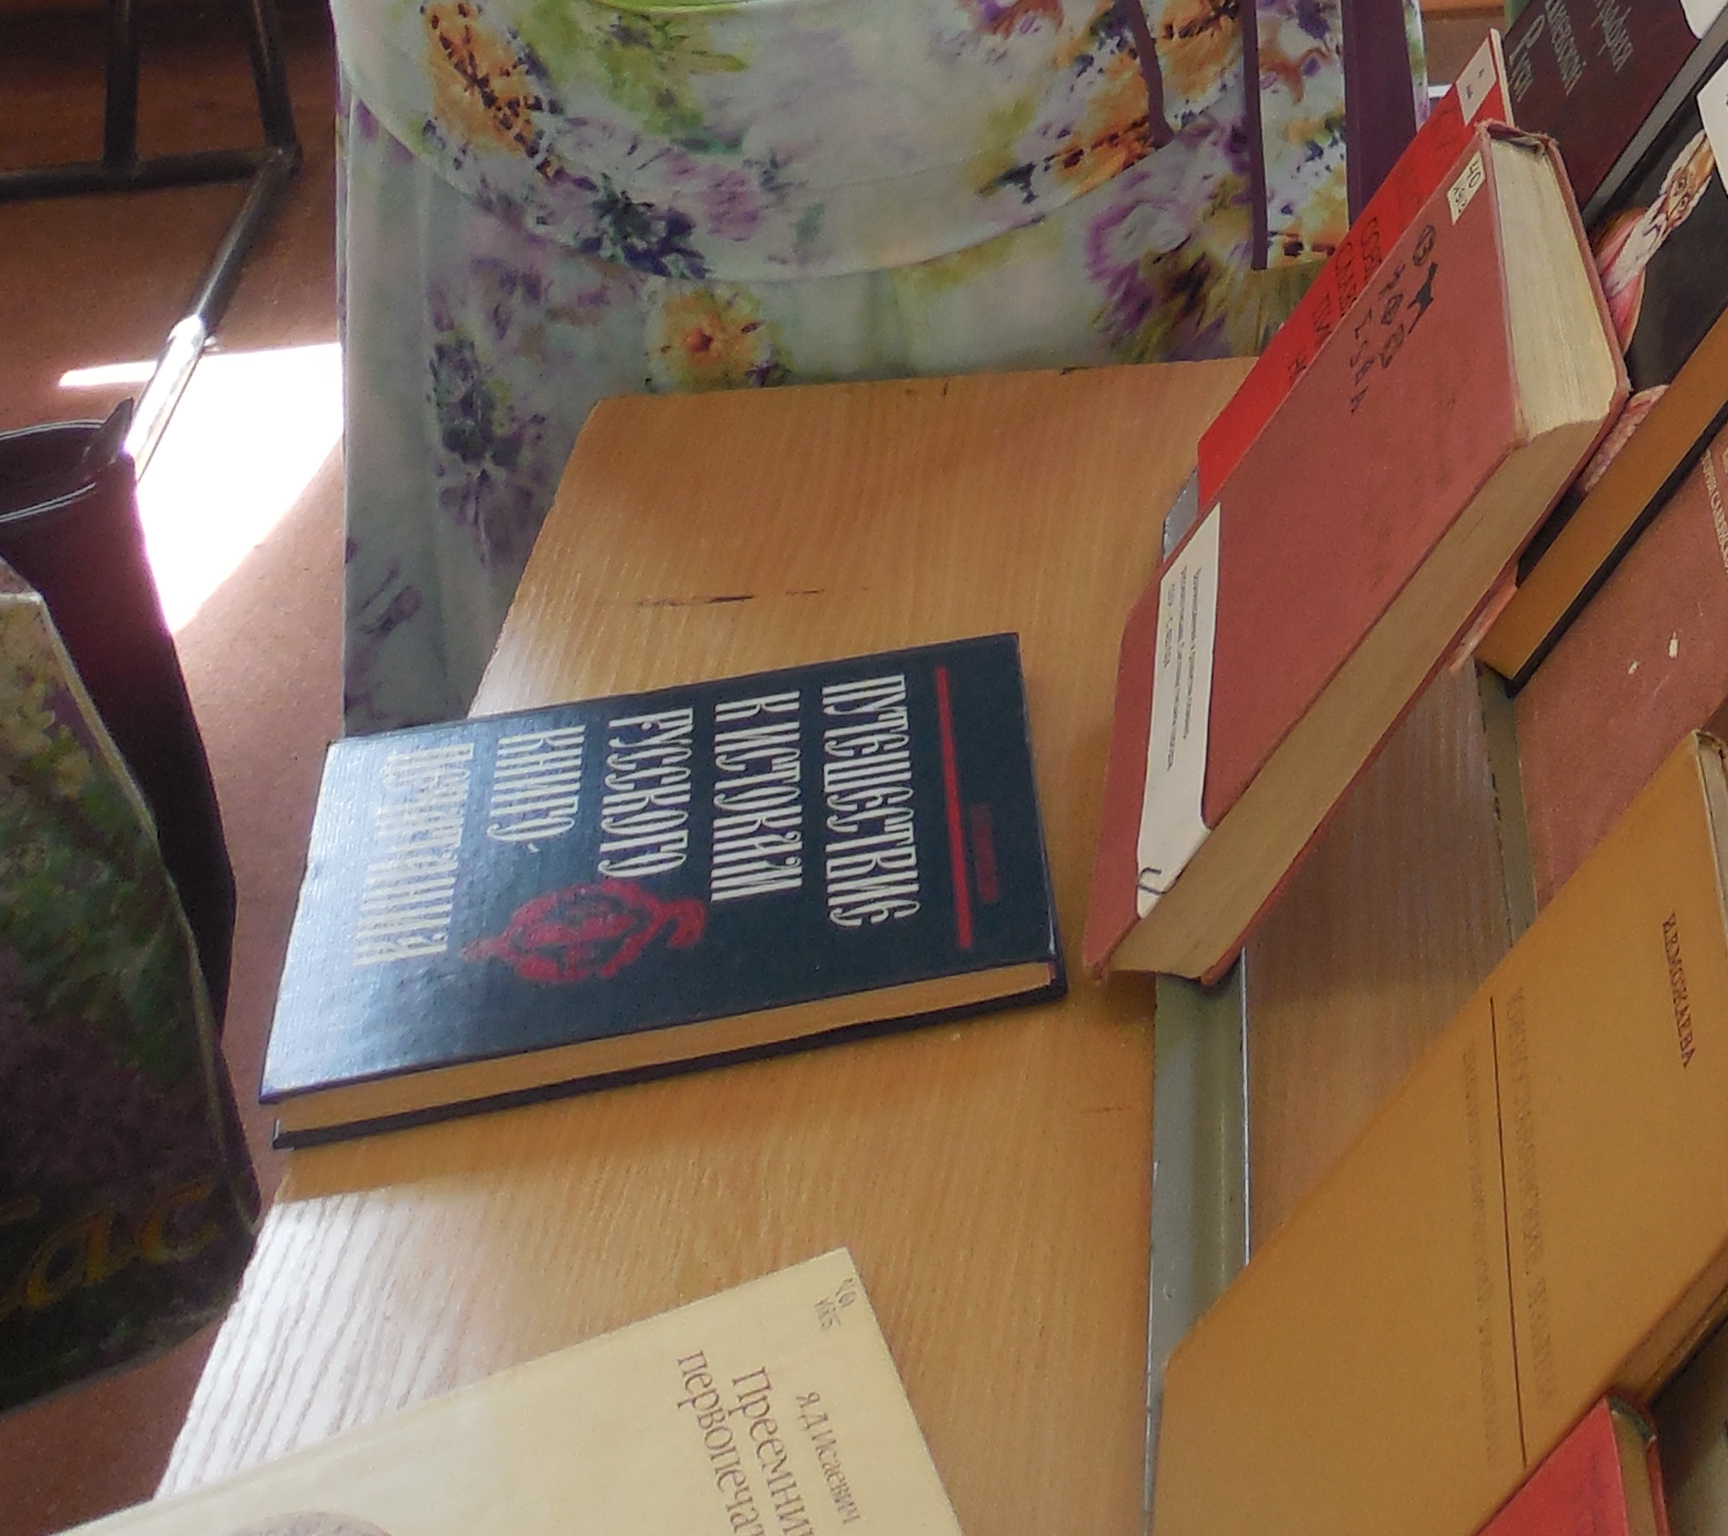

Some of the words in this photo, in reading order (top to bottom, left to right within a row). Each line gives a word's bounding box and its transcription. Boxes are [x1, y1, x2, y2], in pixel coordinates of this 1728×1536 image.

[486, 724, 584, 861] КНИГО-
[713, 690, 799, 722] К
[597, 708, 692, 881] РУССКОГО
[709, 721, 802, 902] ИСТОКАМ
[820, 672, 921, 931] ПУТЕШЕСТВИЕ
